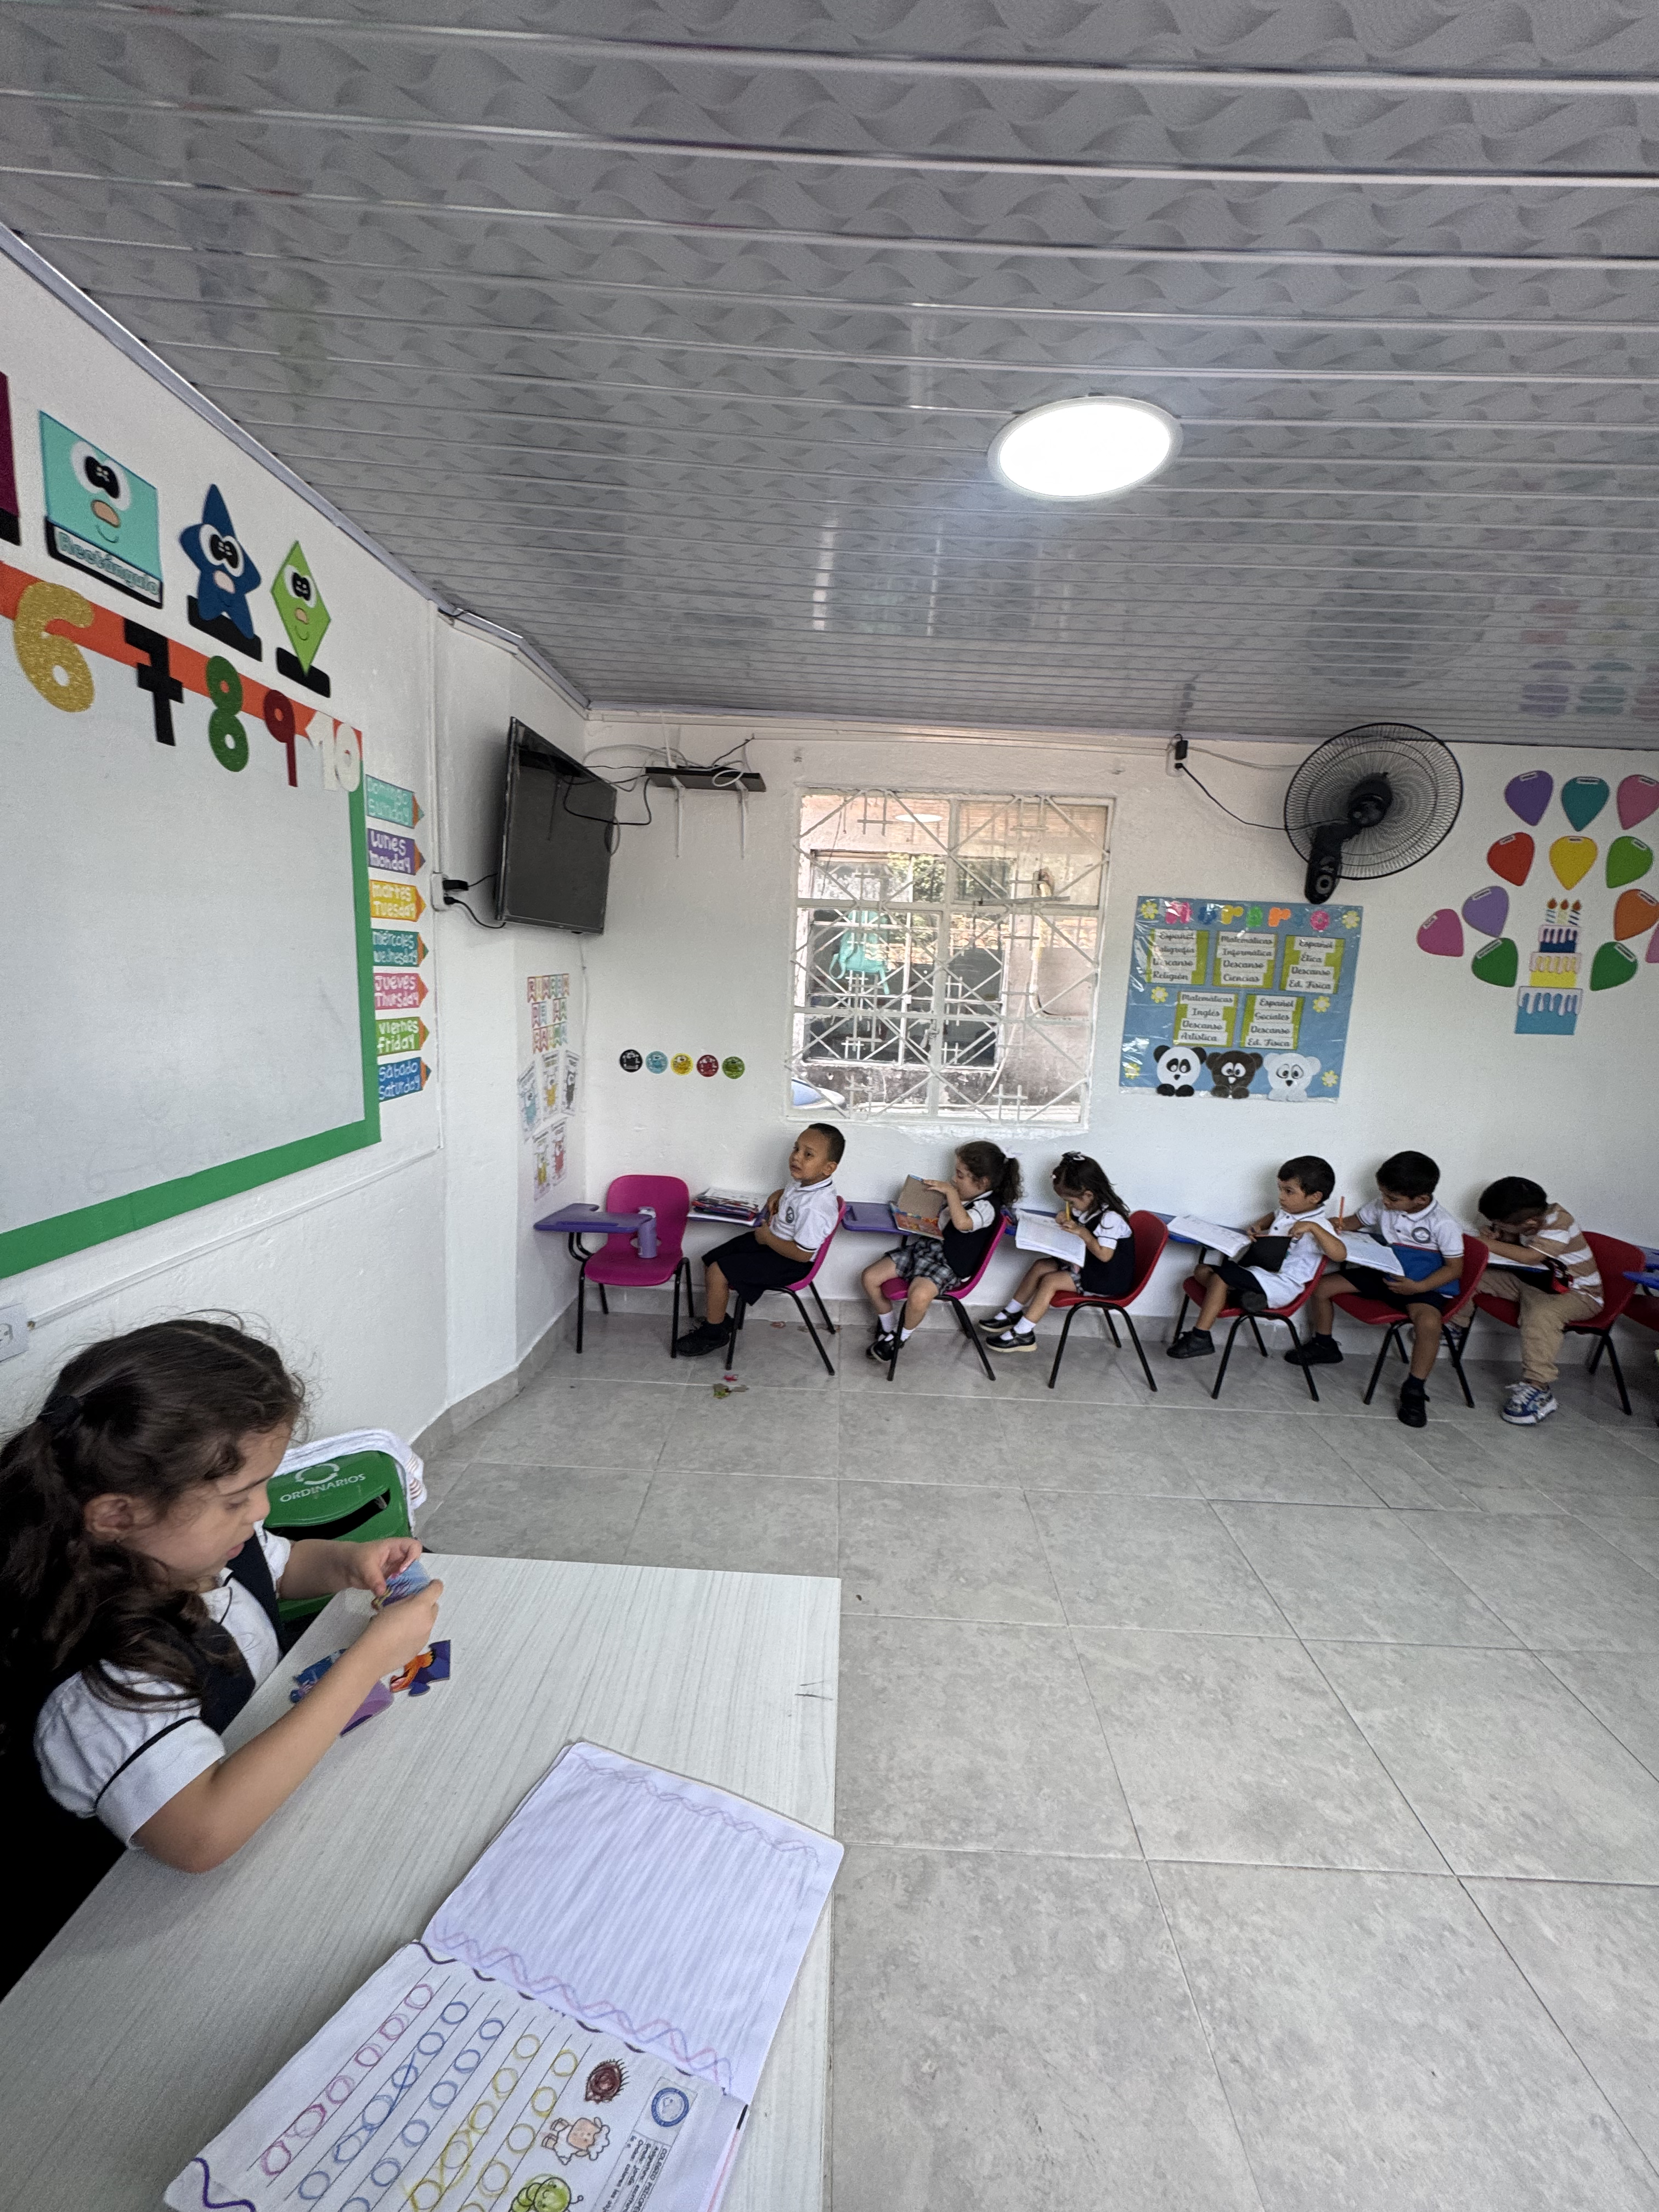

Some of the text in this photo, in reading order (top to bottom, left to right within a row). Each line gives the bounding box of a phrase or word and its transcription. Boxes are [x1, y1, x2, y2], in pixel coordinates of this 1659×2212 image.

[13, 580, 360, 793] 6 7 8 9 10
[371, 830, 406, 856] Lunes
[1223, 960, 1264, 968] Descanso
[1291, 967, 1330, 975] Descanso
[1223, 973, 1260, 982] Ciencias
[1182, 1020, 1223, 1030] Descanso
[1251, 1025, 1290, 1034] Descanso
[279, 1473, 366, 1503] ORDINARIOS
